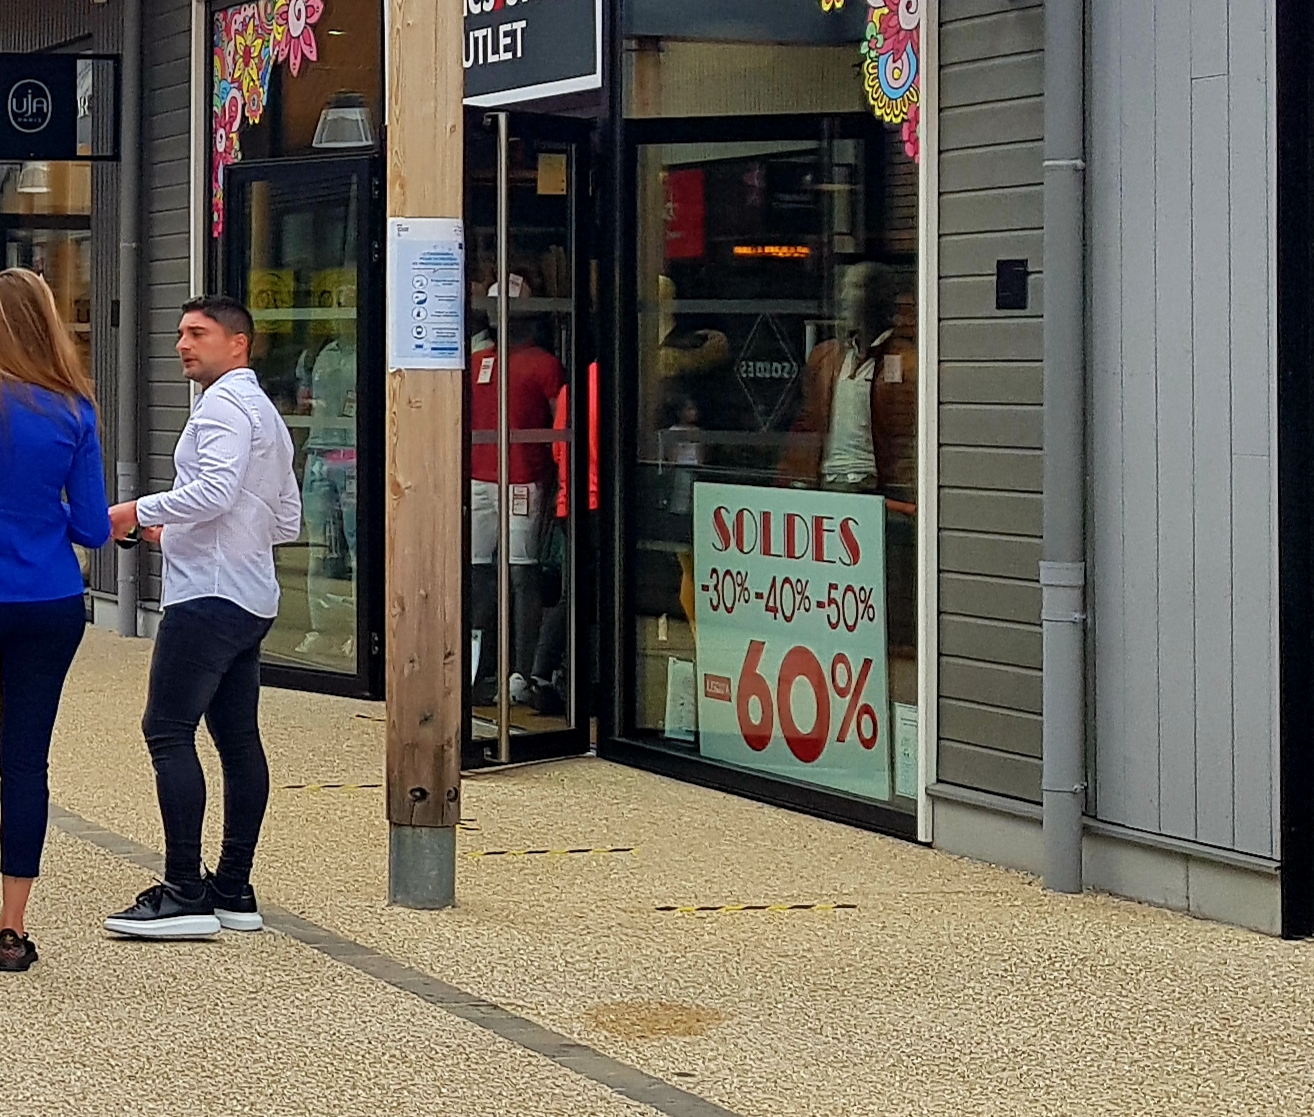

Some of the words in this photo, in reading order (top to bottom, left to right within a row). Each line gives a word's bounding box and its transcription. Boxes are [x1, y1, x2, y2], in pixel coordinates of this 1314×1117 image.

[711, 505, 861, 566] SOLDES
[701, 567, 751, 614] -30%
[755, 575, 812, 623] -40%
[816, 582, 876, 633] -50%
